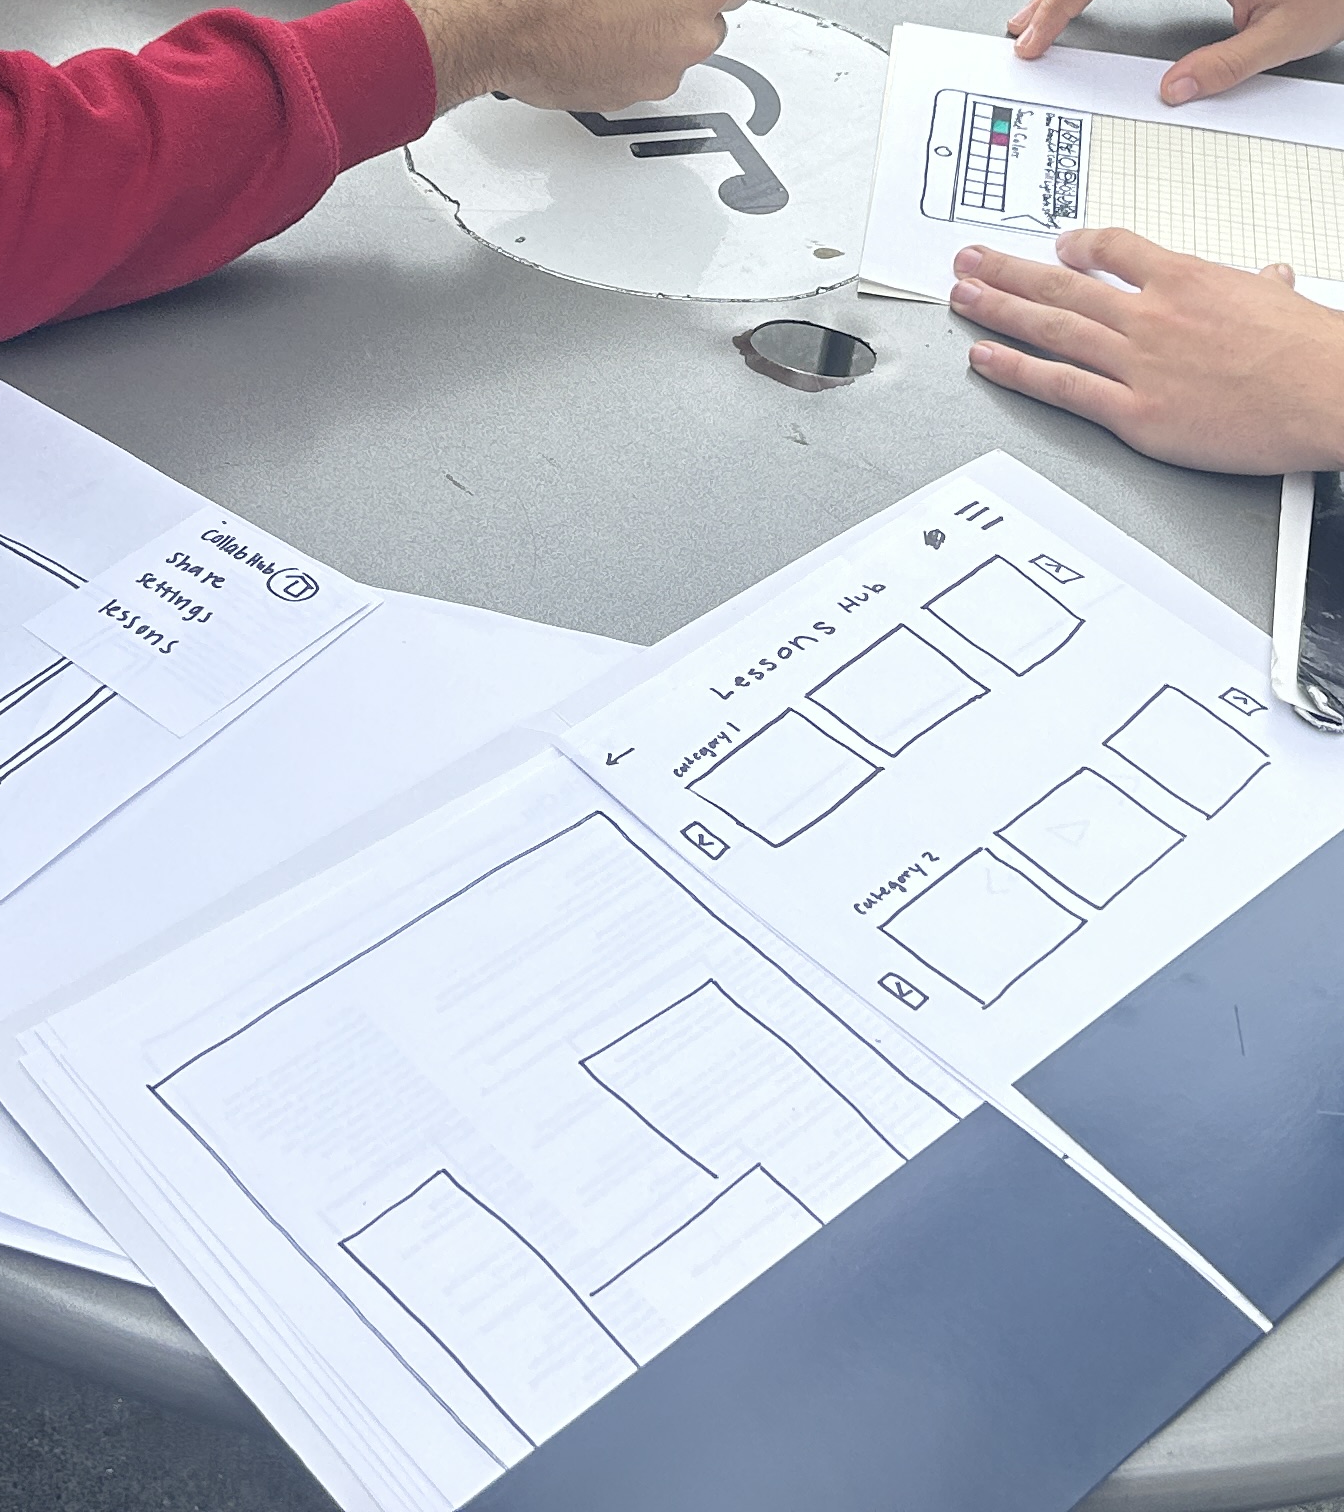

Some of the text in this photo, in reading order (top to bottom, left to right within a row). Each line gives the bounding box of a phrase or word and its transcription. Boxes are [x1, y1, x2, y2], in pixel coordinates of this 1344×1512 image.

[710, 583, 887, 700] Lessons Hub
[726, 721, 741, 732] 1
[921, 851, 941, 862] 2
